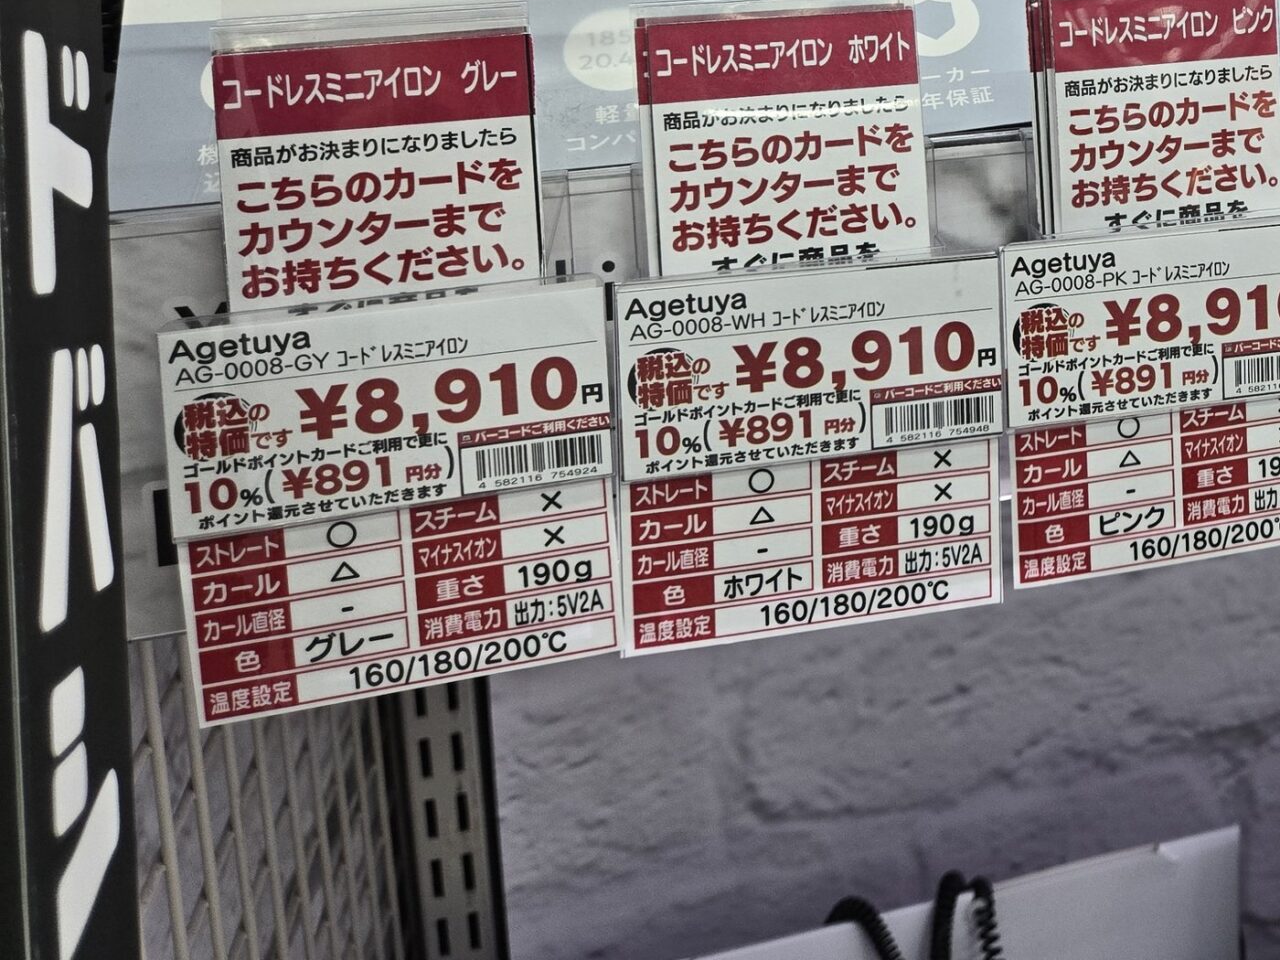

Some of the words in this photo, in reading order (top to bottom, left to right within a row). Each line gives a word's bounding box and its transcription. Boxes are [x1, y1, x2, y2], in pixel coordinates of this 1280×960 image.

[1059, 11, 1218, 47] コードレスミニアイロン
[1232, 5, 1274, 37] ピンク
[656, 37, 834, 77] コードレスミニアイロン
[848, 31, 911, 64] ホワイト
[222, 63, 443, 111] コードレスミニアイロン
[460, 58, 518, 94] グレー
[1064, 64, 1273, 98] 商品がお決まりになりましたら
[1069, 89, 1278, 136] こちらのカードを
[230, 125, 518, 169] 商品がお決まりになりましたら
[668, 121, 915, 173] こちらのカードを
[1070, 127, 1266, 173] カウンターまで
[236, 157, 524, 214] こちらのカードを
[669, 162, 901, 214] カウンターまで
[1071, 162, 1280, 209] お持ちください。
[238, 200, 508, 257] カウンターまで
[672, 201, 917, 252] お持ちください。
[241, 242, 526, 299] お持ちください。
[1010, 251, 1116, 279] Agetuya
[1015, 270, 1127, 296] AG-0008-PK
[624, 288, 748, 321] Agetuya
[630, 312, 766, 341] AG-0008-WH
[168, 330, 312, 365] Agetuya
[175, 351, 329, 386] AG-0008-GY
[1019, 342, 1215, 376] ゴールドポイントカードご利用で更に
[634, 387, 862, 427] ゴールドポイントカードご利用で更に
[1028, 387, 1213, 421] ポイント還元させていただきます
[184, 430, 448, 479] ゴールドポイントカードご利用で更に
[645, 435, 860, 475] ポイント還元させていただきます
[199, 482, 448, 530] ポイント還元させていただきます
[634, 480, 709, 508] ストレート
[638, 514, 707, 542] カール
[825, 488, 894, 517] マイナスイオン
[195, 537, 281, 568] ストレート
[415, 501, 498, 534] スチーム
[909, 513, 975, 539] 190g
[1099, 505, 1165, 536] ピンク
[202, 576, 281, 605] カール
[417, 538, 498, 566] マイナスイオン
[723, 567, 803, 600] ホワイト
[203, 608, 286, 642] カール直径
[435, 575, 486, 603] 重さ
[517, 558, 594, 589] 190g
[639, 613, 712, 645] 温度設定
[760, 578, 951, 627] 160/180/200℃
[234, 649, 262, 672] 色
[304, 628, 395, 663] グレー
[424, 606, 502, 641] 消費電力
[209, 680, 294, 716] 温度設定
[348, 630, 568, 690] 160/180/200℃
